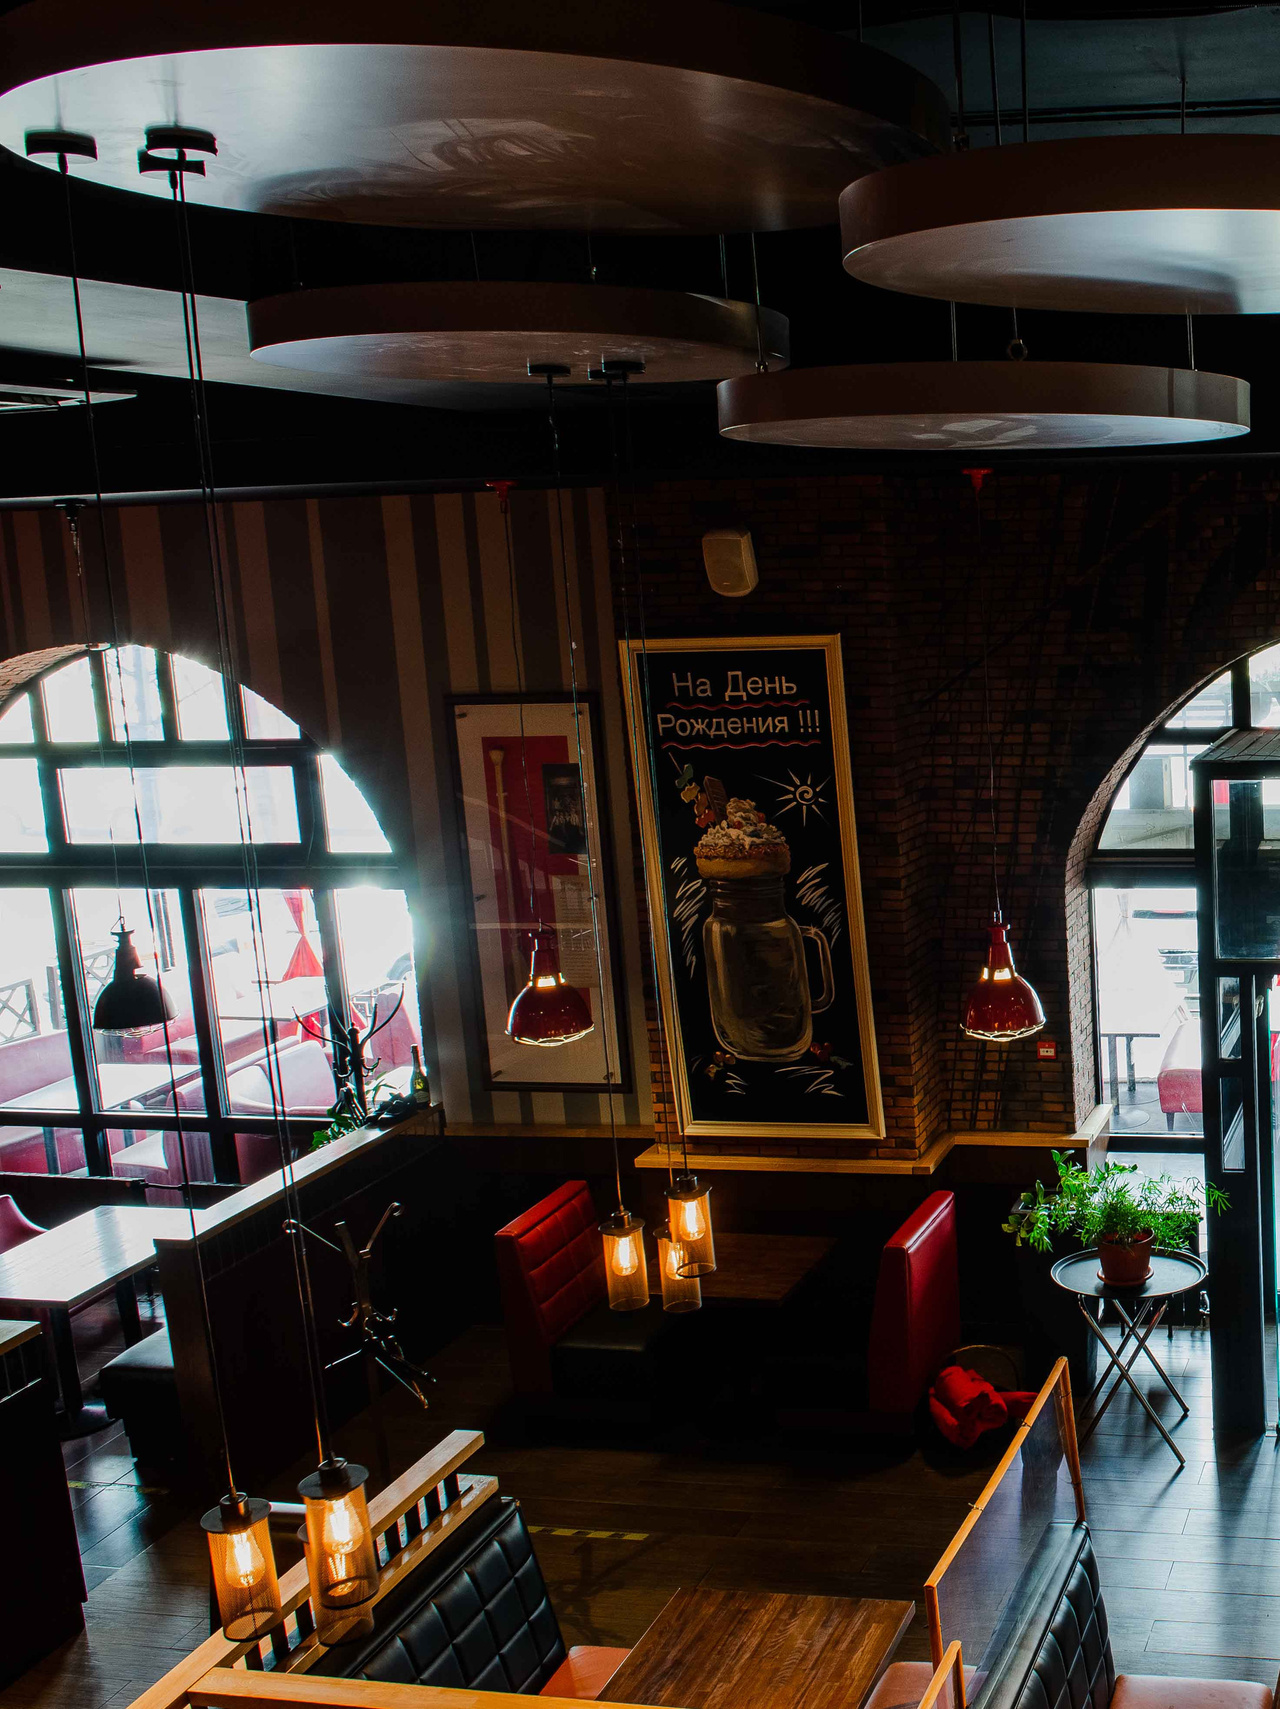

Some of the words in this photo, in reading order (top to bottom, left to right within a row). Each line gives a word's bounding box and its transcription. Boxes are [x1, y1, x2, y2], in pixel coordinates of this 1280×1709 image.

[672, 672, 712, 697] На
[724, 670, 797, 702] День
[656, 713, 789, 739] Рождения
